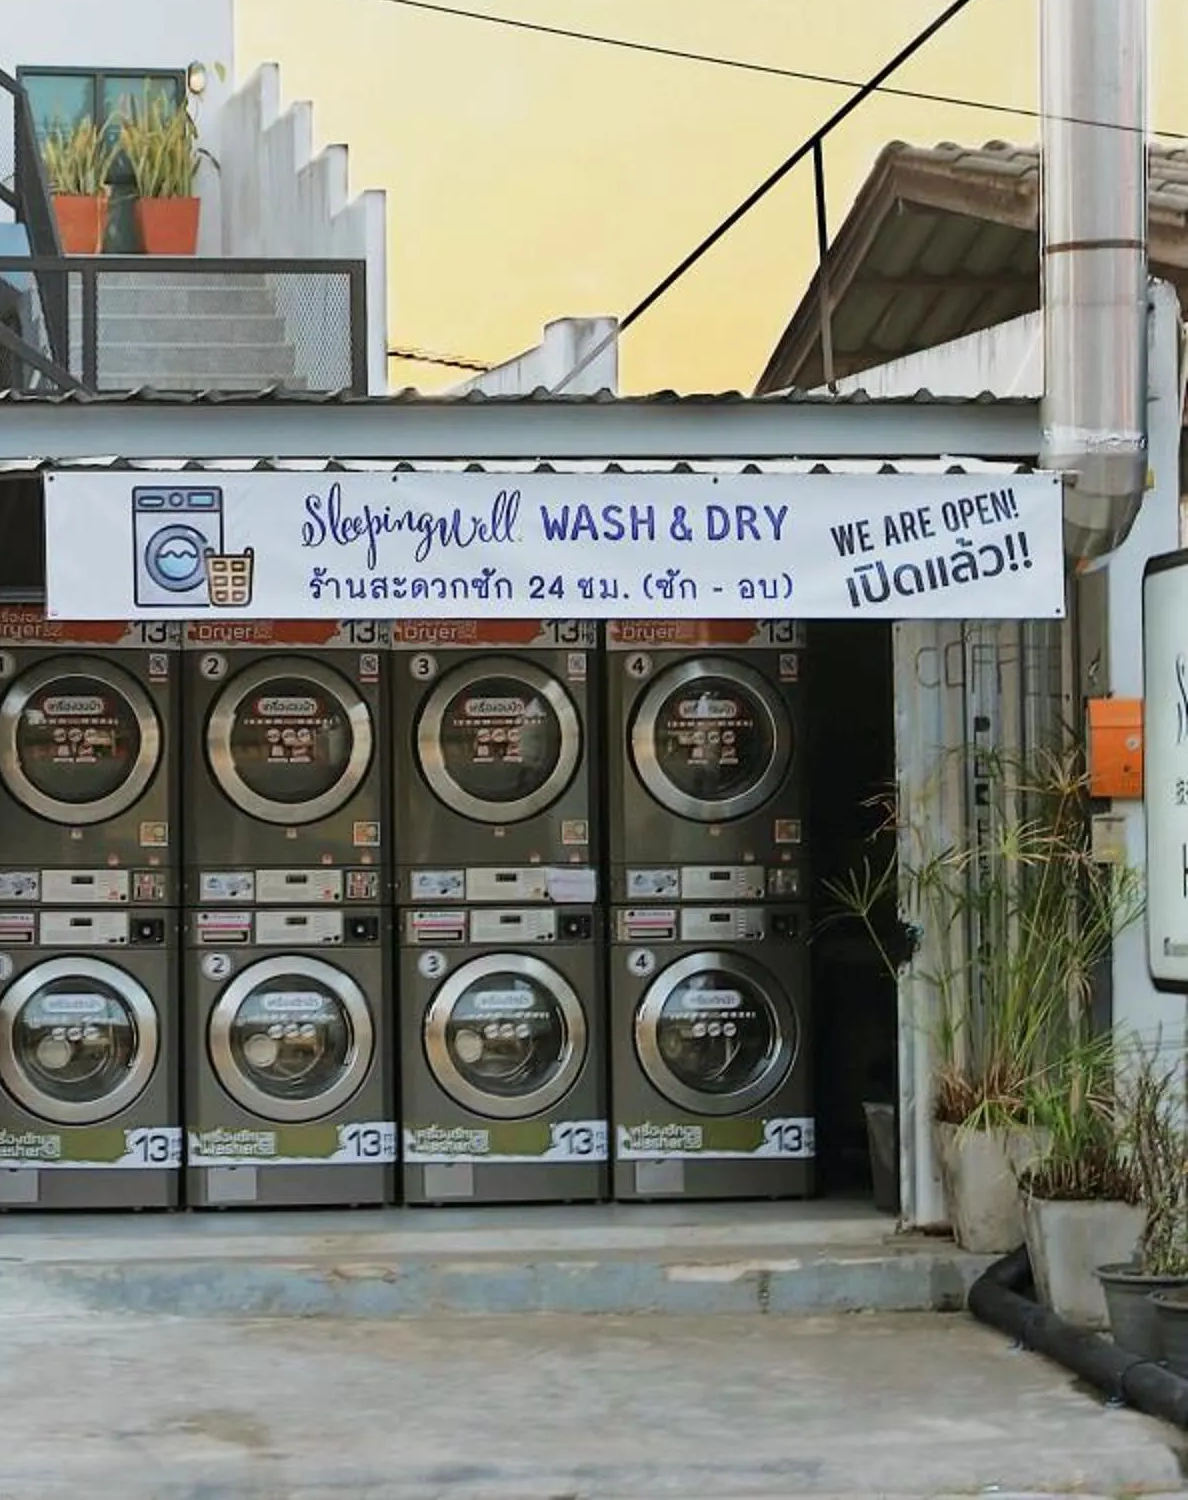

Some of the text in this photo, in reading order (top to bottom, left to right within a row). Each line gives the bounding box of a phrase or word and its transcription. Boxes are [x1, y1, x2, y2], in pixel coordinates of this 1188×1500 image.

[540, 504, 655, 541] WASH
[670, 505, 693, 541] &
[706, 505, 789, 541] DRY
[830, 488, 1019, 557] WE ARE OPEN!
[845, 531, 1033, 608] เปิดแล้ว!!
[528, 575, 564, 599] 24
[134, 620, 167, 643] 13
[199, 625, 251, 640] Dryer
[343, 619, 376, 643] 13
[546, 619, 579, 643] 13
[758, 619, 793, 643] 13
[208, 657, 220, 674] 2
[418, 657, 429, 674] 3
[632, 657, 644, 674] 4
[212, 957, 224, 973] 2
[427, 955, 438, 973] 3
[636, 954, 647, 969] 4
[135, 1135, 169, 1162] 13
[348, 1130, 381, 1157] 13
[560, 1128, 594, 1154] 13
[771, 1125, 802, 1152] 13
